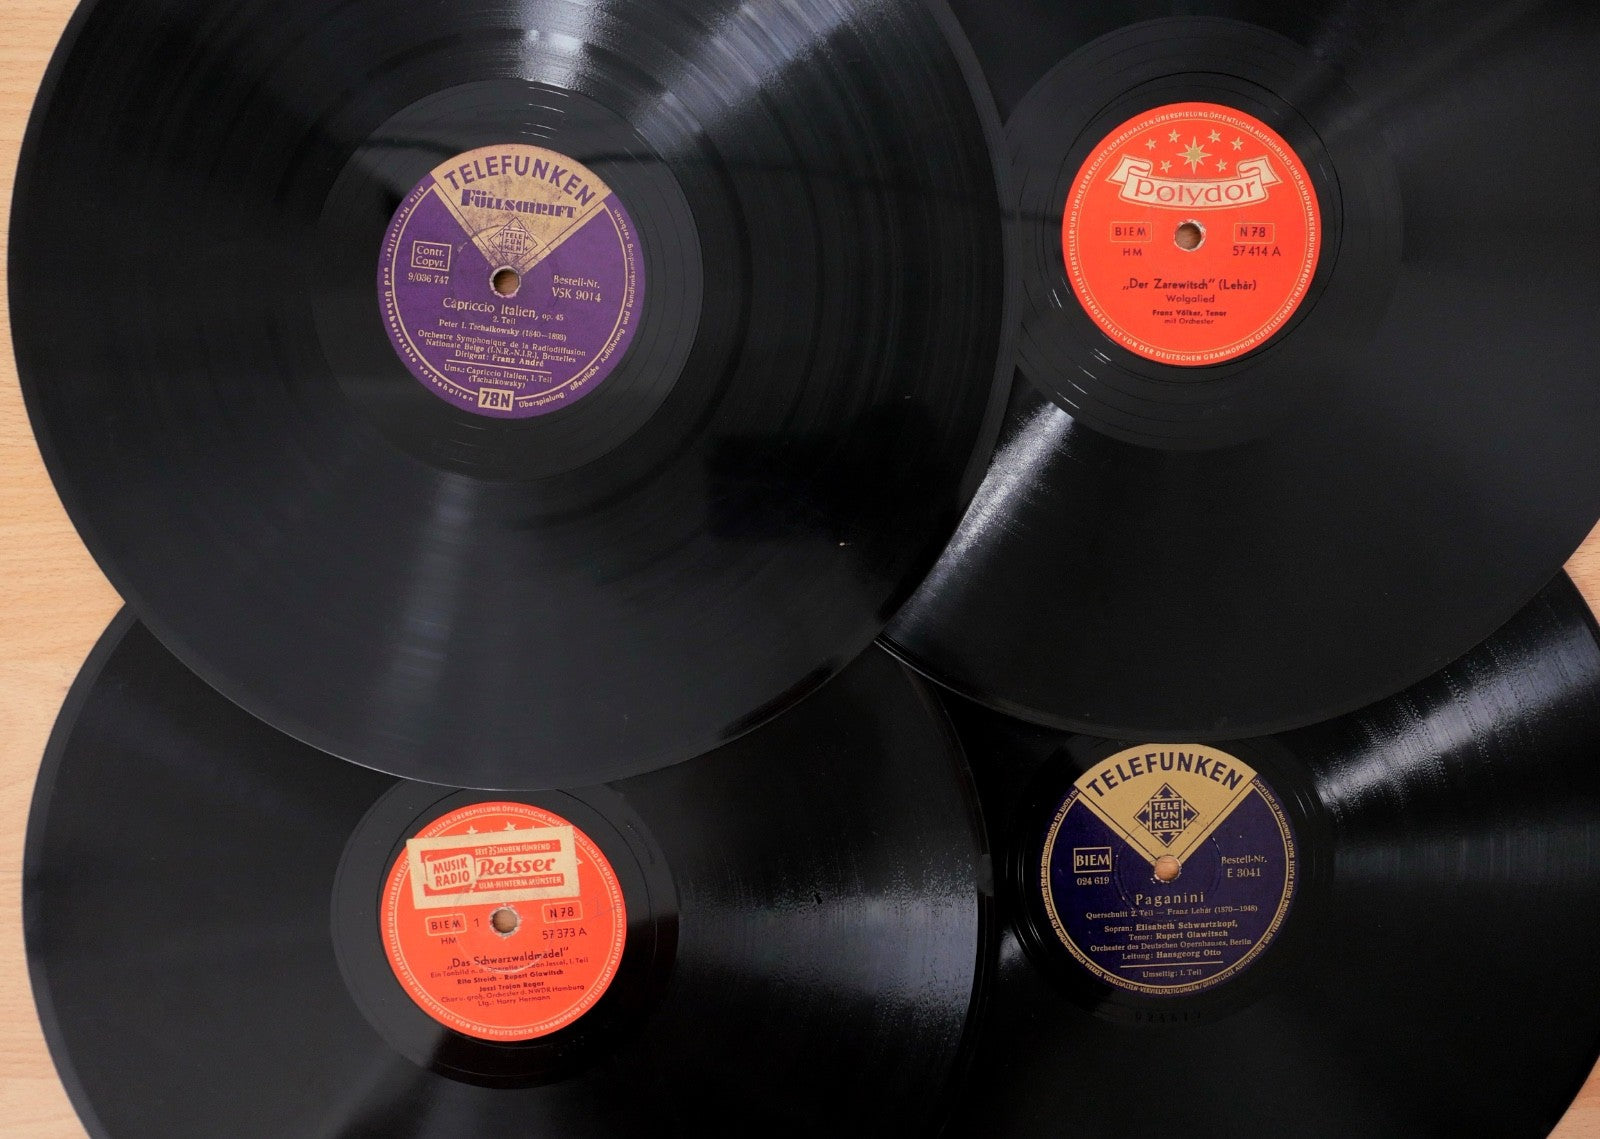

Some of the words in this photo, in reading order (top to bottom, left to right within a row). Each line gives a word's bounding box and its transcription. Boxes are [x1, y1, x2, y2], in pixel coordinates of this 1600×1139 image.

[444, 155, 596, 207] TELEFUNKEN
[505, 232, 523, 240] TELE
[1114, 226, 1146, 236] BIEM
[1240, 227, 1248, 237] N
[1251, 227, 1266, 238] 78
[504, 238, 522, 246] FUN
[416, 245, 445, 257] Contr.
[1272, 246, 1281, 256] A
[415, 256, 446, 268] Copyr.
[408, 272, 432, 283] 9/036
[434, 275, 450, 285] 747
[553, 274, 600, 289] Bestell-Nr.
[1218, 279, 1257, 291] (Lehár)
[552, 287, 572, 298] VSK
[576, 290, 602, 303] 9014
[1166, 294, 1215, 304] Wolgalied
[443, 297, 495, 313] Capriccio
[501, 304, 539, 320] Italien,
[542, 314, 554, 322] op.
[555, 314, 564, 322] 45
[1176, 309, 1202, 317] Völker,
[501, 316, 516, 324] Teil
[439, 319, 458, 328] Peter
[469, 323, 520, 336] Tschaikowsky
[418, 330, 454, 340] Orchestre
[456, 334, 506, 348] Symphonique
[510, 340, 519, 348] de
[522, 342, 529, 350] la
[532, 344, 586, 356] Radiodiffusion
[1122, 336, 1138, 348] VON
[1138, 343, 1154, 354] DER
[1155, 350, 1202, 362] DEUTSCHEN
[1203, 338, 1256, 361] GRAMMOPHON
[426, 339, 461, 349] Nationale
[464, 343, 484, 352] Belge
[542, 353, 576, 363] Bruxelles
[455, 350, 489, 360] Dirigent:
[492, 354, 516, 364] Franz
[518, 358, 544, 367] André
[466, 366, 501, 378] Capriccio
[503, 371, 529, 382] Italien,
[538, 376, 552, 384] Teil
[468, 375, 526, 388] (Tschaikowsky)
[481, 390, 511, 408] 78N
[1086, 752, 1244, 798] TELEFUNKEN
[1153, 802, 1180, 810] TELE
[1154, 812, 1179, 820] FUN
[1154, 820, 1180, 829] KEN
[1076, 854, 1110, 867] BIEM
[1221, 854, 1268, 864] Bestell-Nr.
[433, 857, 468, 875] MUSIK
[476, 856, 556, 878] Reisser
[435, 870, 470, 888] RADIO
[1227, 868, 1233, 878] E
[1236, 868, 1262, 877] 3041
[1076, 878, 1092, 886] 024
[1094, 876, 1110, 885] 619
[1136, 892, 1204, 907] Paganini
[550, 909, 558, 918] N
[560, 906, 574, 918] 78
[1086, 911, 1128, 920] Querschnitt
[1168, 908, 1188, 916] Franz
[1191, 906, 1211, 914] Lehár
[432, 920, 461, 930] BIEM
[1104, 926, 1133, 934] Sopran:
[1136, 922, 1175, 931] Elisabeth
[1178, 920, 1238, 930] Schwartzkopf,
[578, 927, 588, 937] A
[1156, 932, 1184, 940] Rupert
[1186, 930, 1228, 938] Glawitsch
[1090, 944, 1126, 952] Orchester
[1141, 942, 1178, 950] Deutschen
[1180, 940, 1228, 948] Opernhauses,
[1230, 938, 1252, 946] Berlin
[1122, 952, 1154, 960] Leitung:
[1156, 950, 1200, 958] Hansgeorg
[474, 976, 497, 984] Streich
[504, 973, 528, 982] Rupert
[530, 970, 564, 978] Glawitsch
[1142, 970, 1178, 978] Umseitig:
[1188, 968, 1202, 976] Teil
[498, 983, 520, 992] Trojan
[552, 984, 585, 992] Hamburg
[496, 998, 516, 1006] Harry
[518, 995, 551, 1003] Hermann
